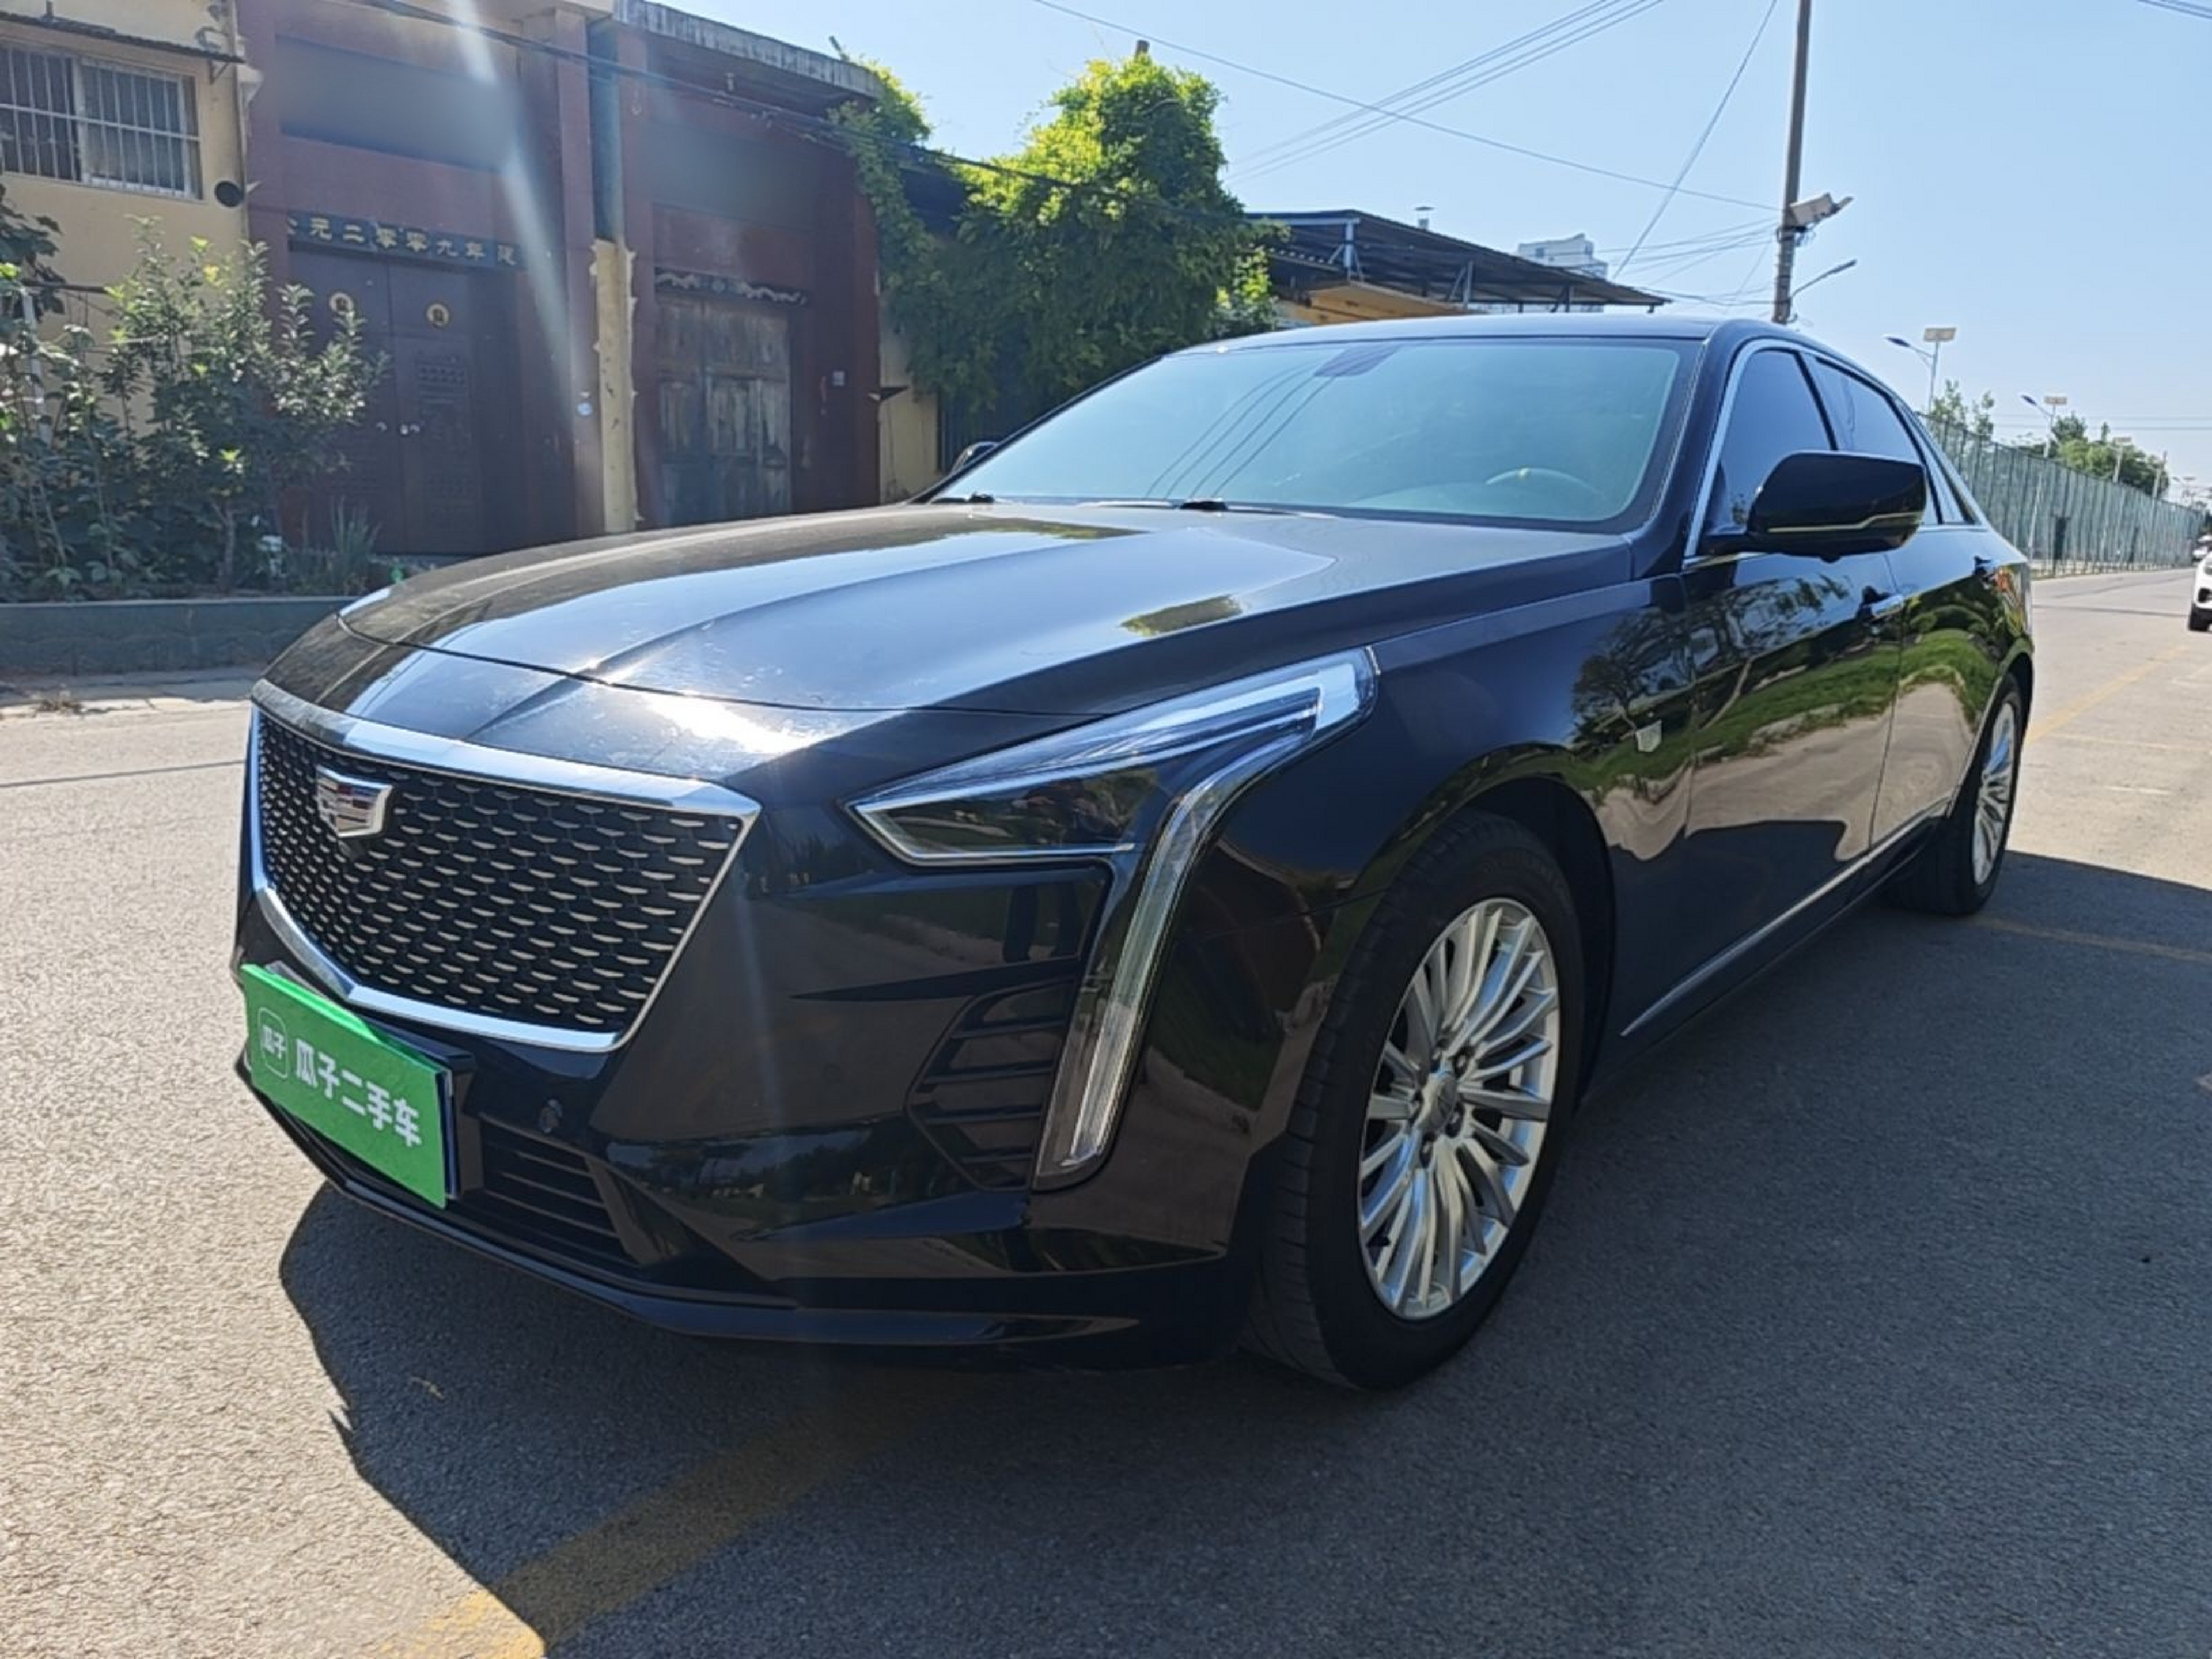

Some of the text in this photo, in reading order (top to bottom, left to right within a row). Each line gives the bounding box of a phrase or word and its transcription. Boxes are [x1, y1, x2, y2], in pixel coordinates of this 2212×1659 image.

[296, 1038, 422, 1147] 瓜子二手车
